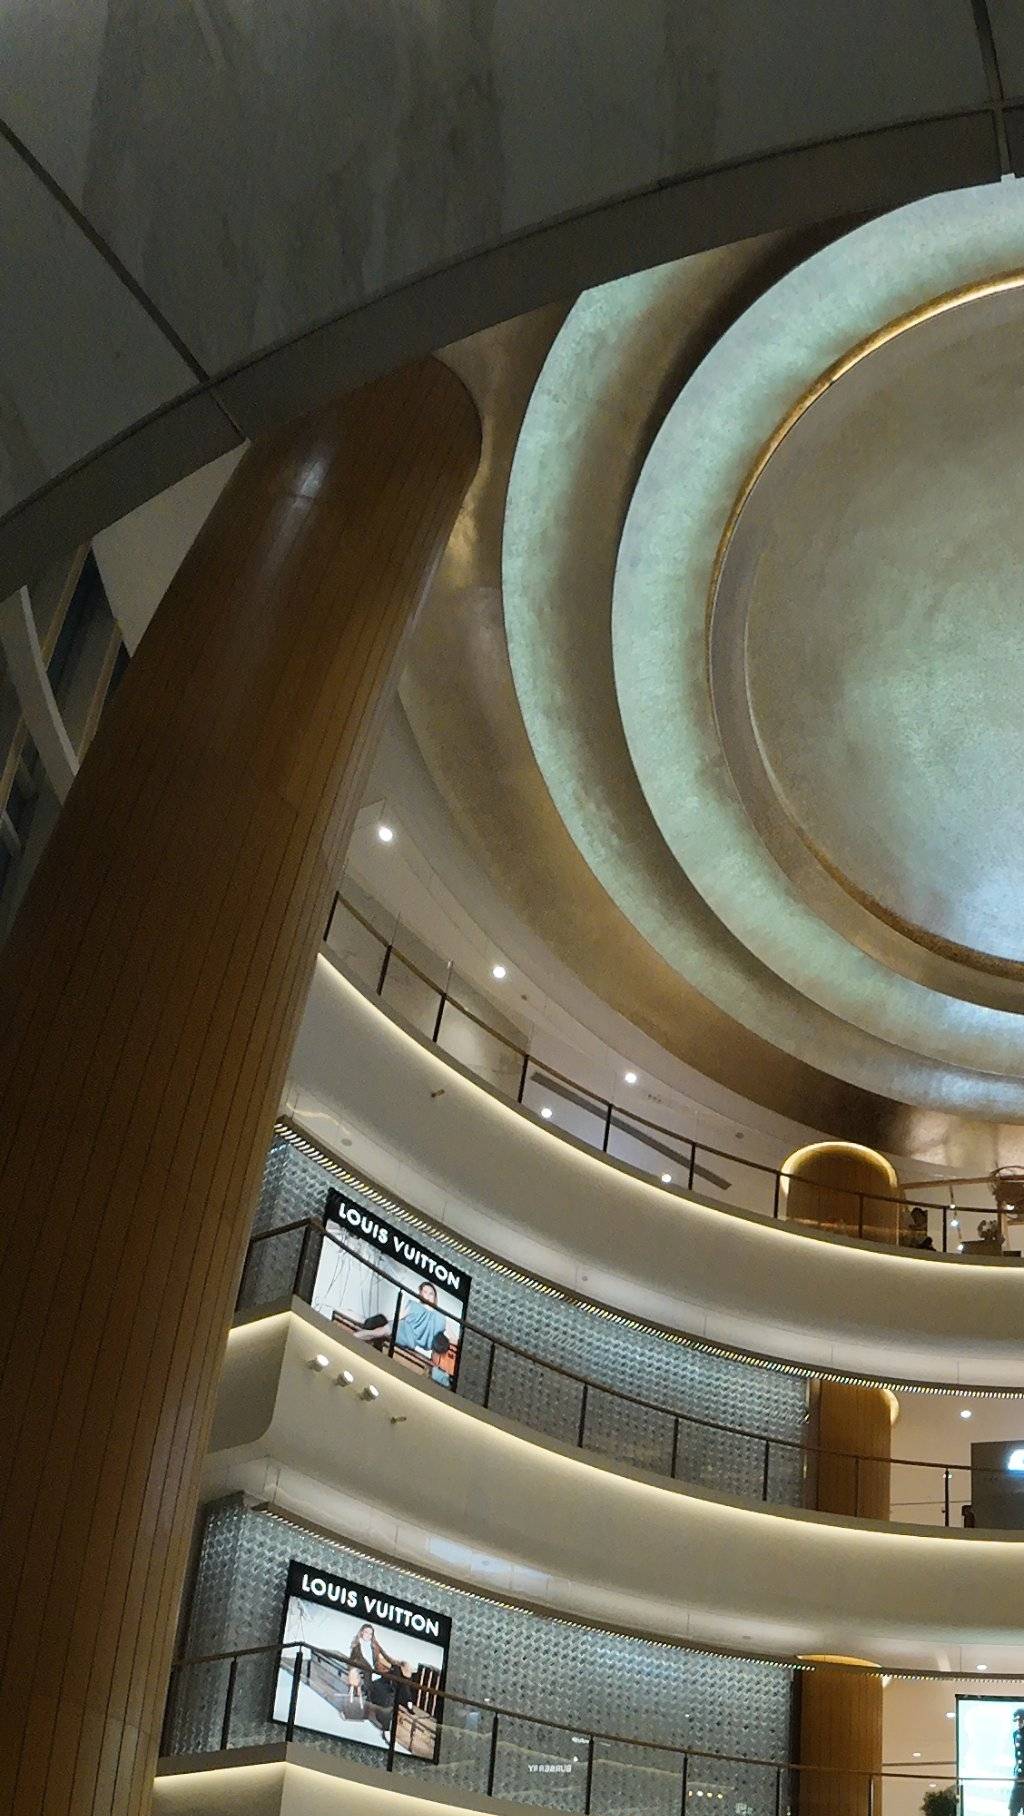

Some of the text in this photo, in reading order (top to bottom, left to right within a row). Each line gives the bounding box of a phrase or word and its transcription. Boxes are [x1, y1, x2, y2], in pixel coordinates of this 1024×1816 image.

[338, 1203, 461, 1290] LOUIS VUITTON
[301, 1574, 440, 1637] LOUIS VUITTON
